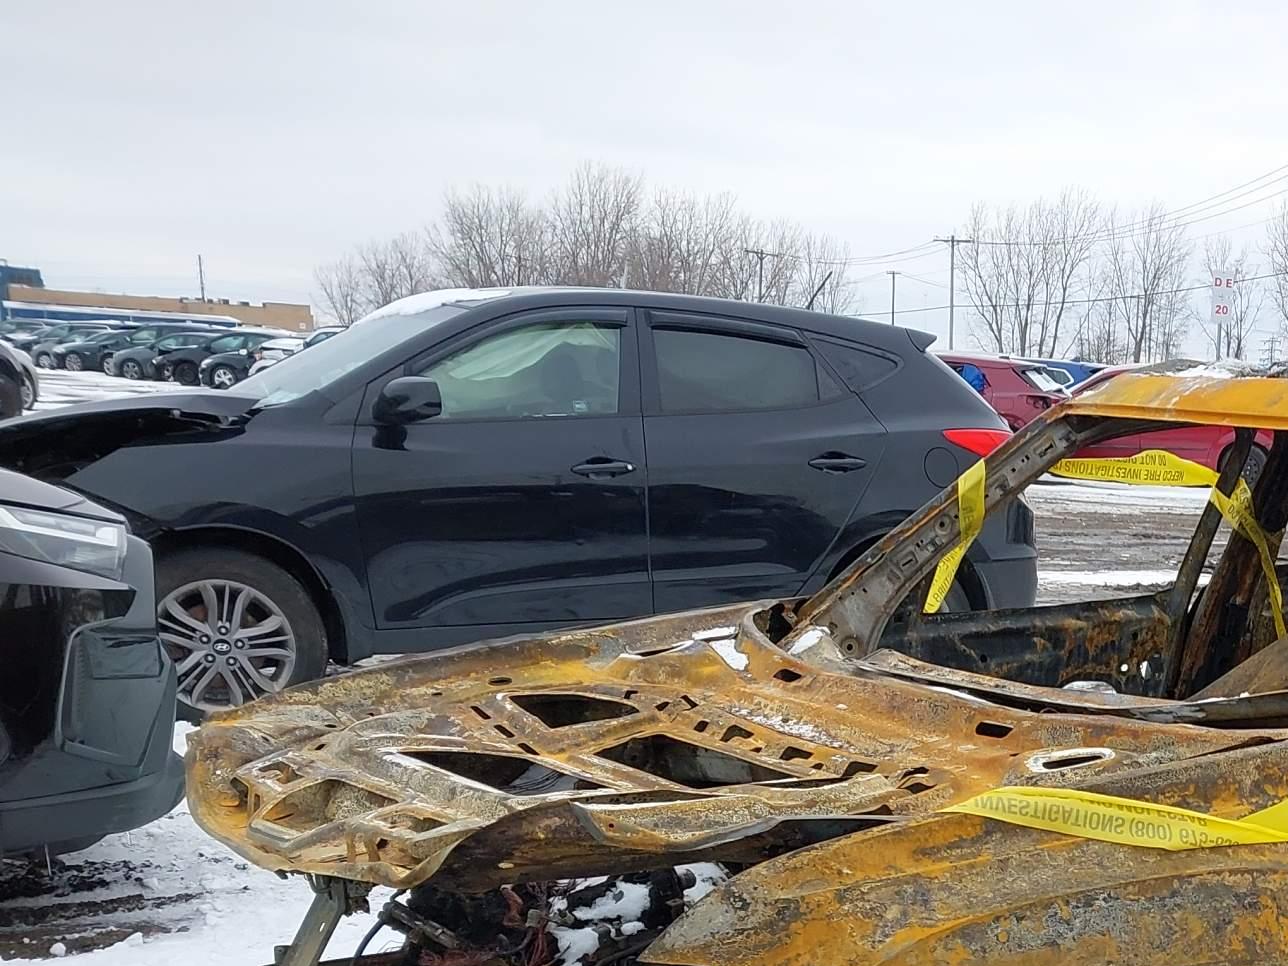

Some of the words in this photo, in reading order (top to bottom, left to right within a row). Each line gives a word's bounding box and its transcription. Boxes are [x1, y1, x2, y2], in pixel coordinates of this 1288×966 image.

[1215, 305, 1228, 315] 20
[1064, 460, 1142, 481] INVESTIGATIONS
[1143, 468, 1162, 481] FIRE
